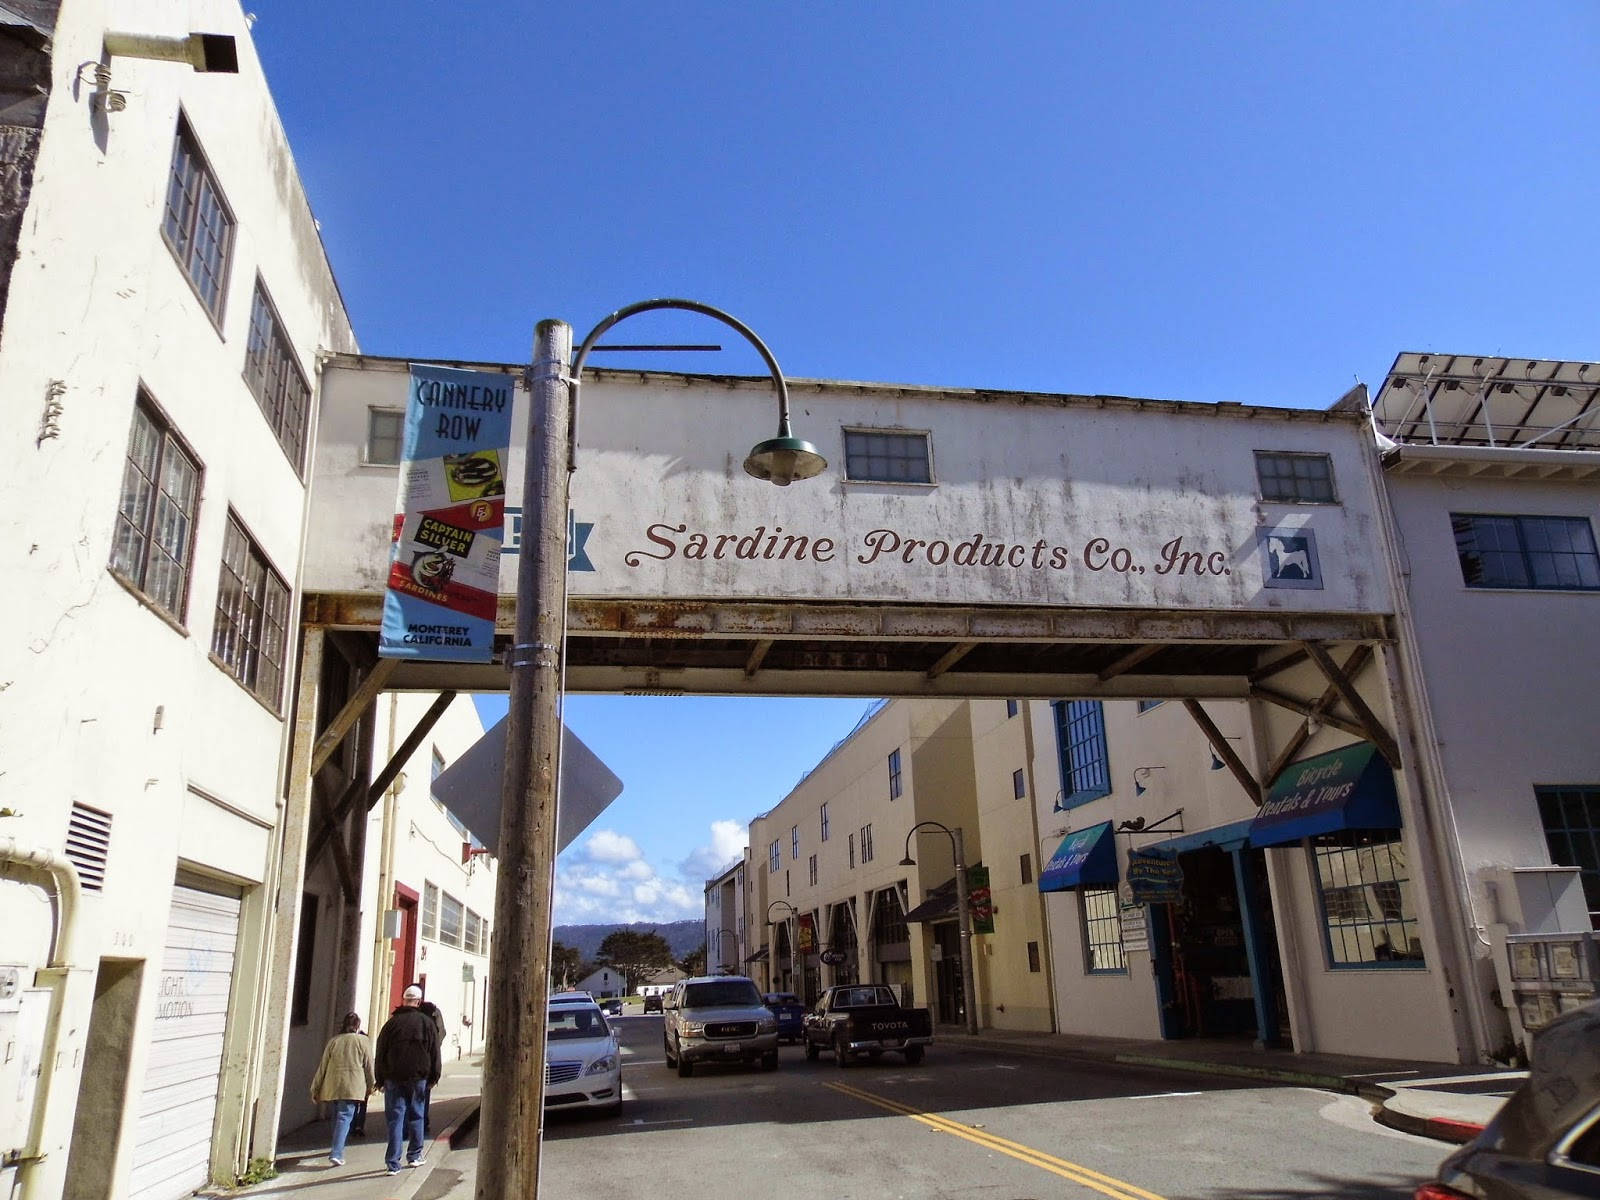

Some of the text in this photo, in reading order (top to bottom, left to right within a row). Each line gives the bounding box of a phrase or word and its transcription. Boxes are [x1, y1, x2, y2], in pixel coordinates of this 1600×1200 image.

[417, 380, 506, 412] CANNERY
[436, 413, 481, 441] ROW
[420, 530, 466, 552] SILVER
[423, 519, 473, 542] CAPTAIN
[624, 523, 836, 567] Sardine
[857, 529, 1068, 570] Products
[1154, 535, 1231, 576] Inc.
[399, 579, 448, 602] SARDINES
[403, 635, 472, 647] CALIFORNIA
[408, 624, 470, 635] MONTEREY
[1296, 759, 1344, 787] Bicycle
[1257, 781, 1355, 818] Rentals & Tours
[872, 1021, 908, 1031] TOYOTA
